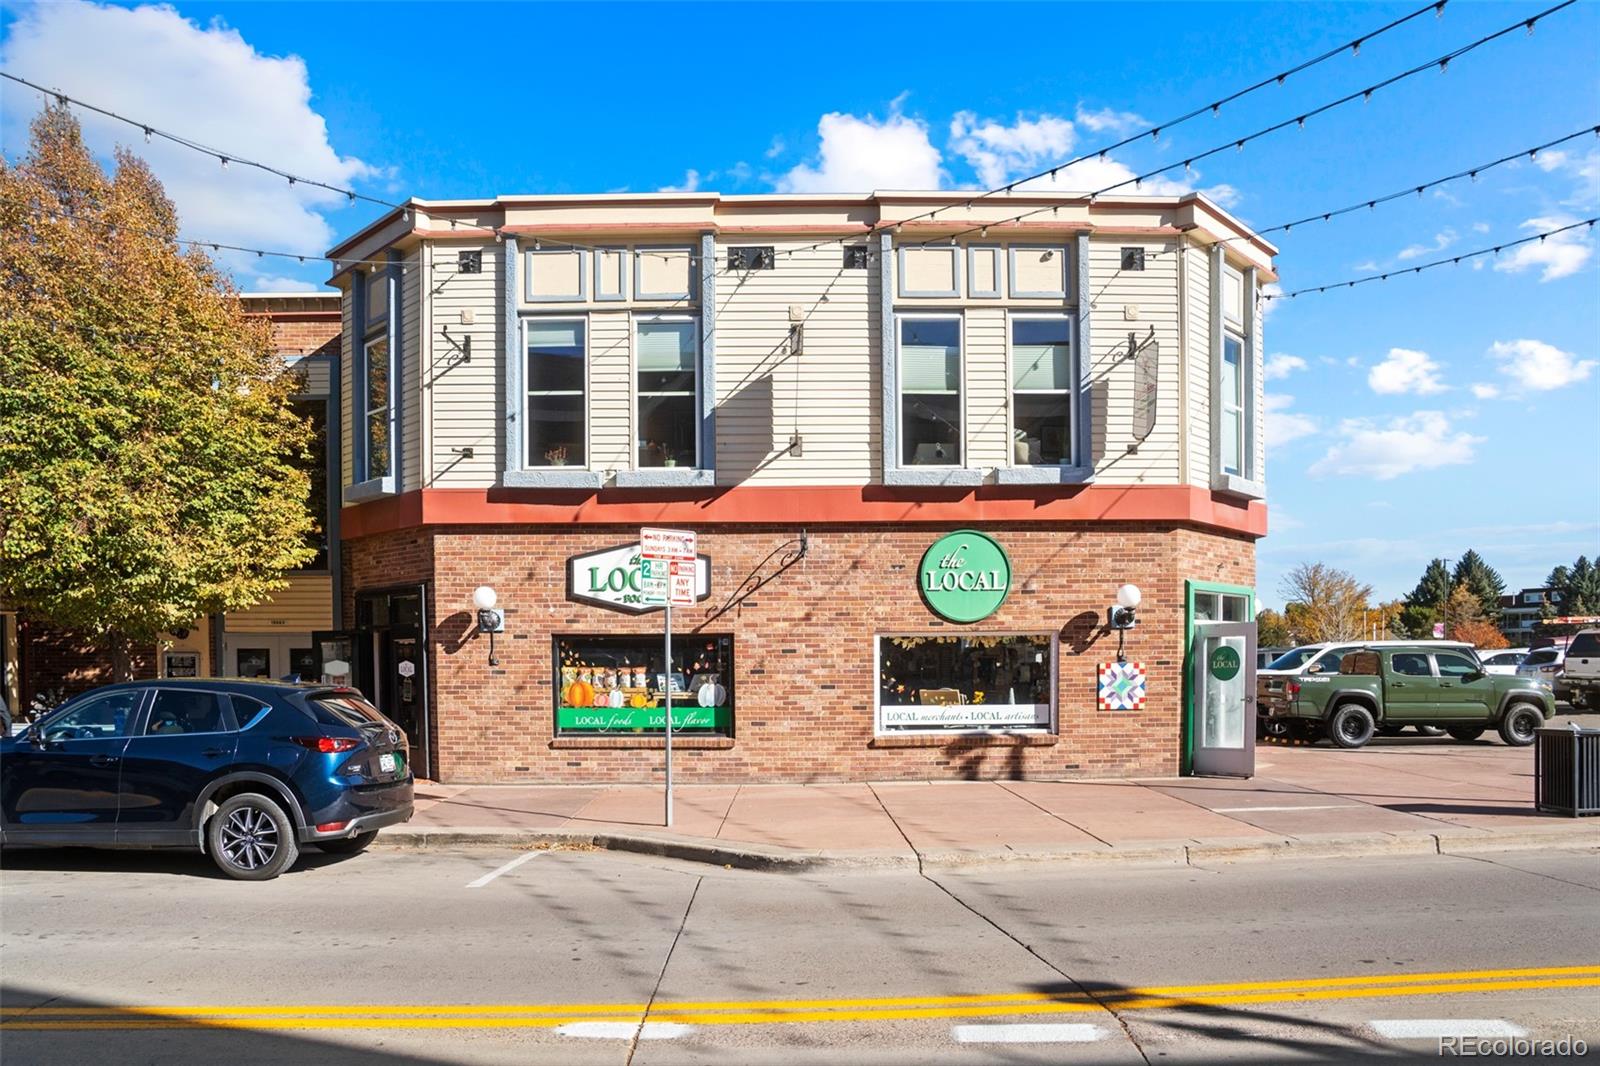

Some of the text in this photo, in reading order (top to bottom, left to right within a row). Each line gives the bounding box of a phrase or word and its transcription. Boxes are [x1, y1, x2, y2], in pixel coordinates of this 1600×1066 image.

[663, 534, 684, 543] PARKING
[644, 544, 666, 552] SUNDAYS
[629, 553, 641, 565] th
[939, 544, 969, 569] the
[643, 562, 650, 575] 2
[588, 566, 641, 592] LOC
[676, 578, 690, 587] ANY
[926, 570, 1007, 592] LOCAL
[675, 588, 691, 598] TIME
[1213, 660, 1238, 669] LOCAL
[887, 709, 1039, 721] LOCAL merchants LOCAL artisans
[575, 711, 636, 733] LOCAL foods
[673, 711, 711, 733] flavor
